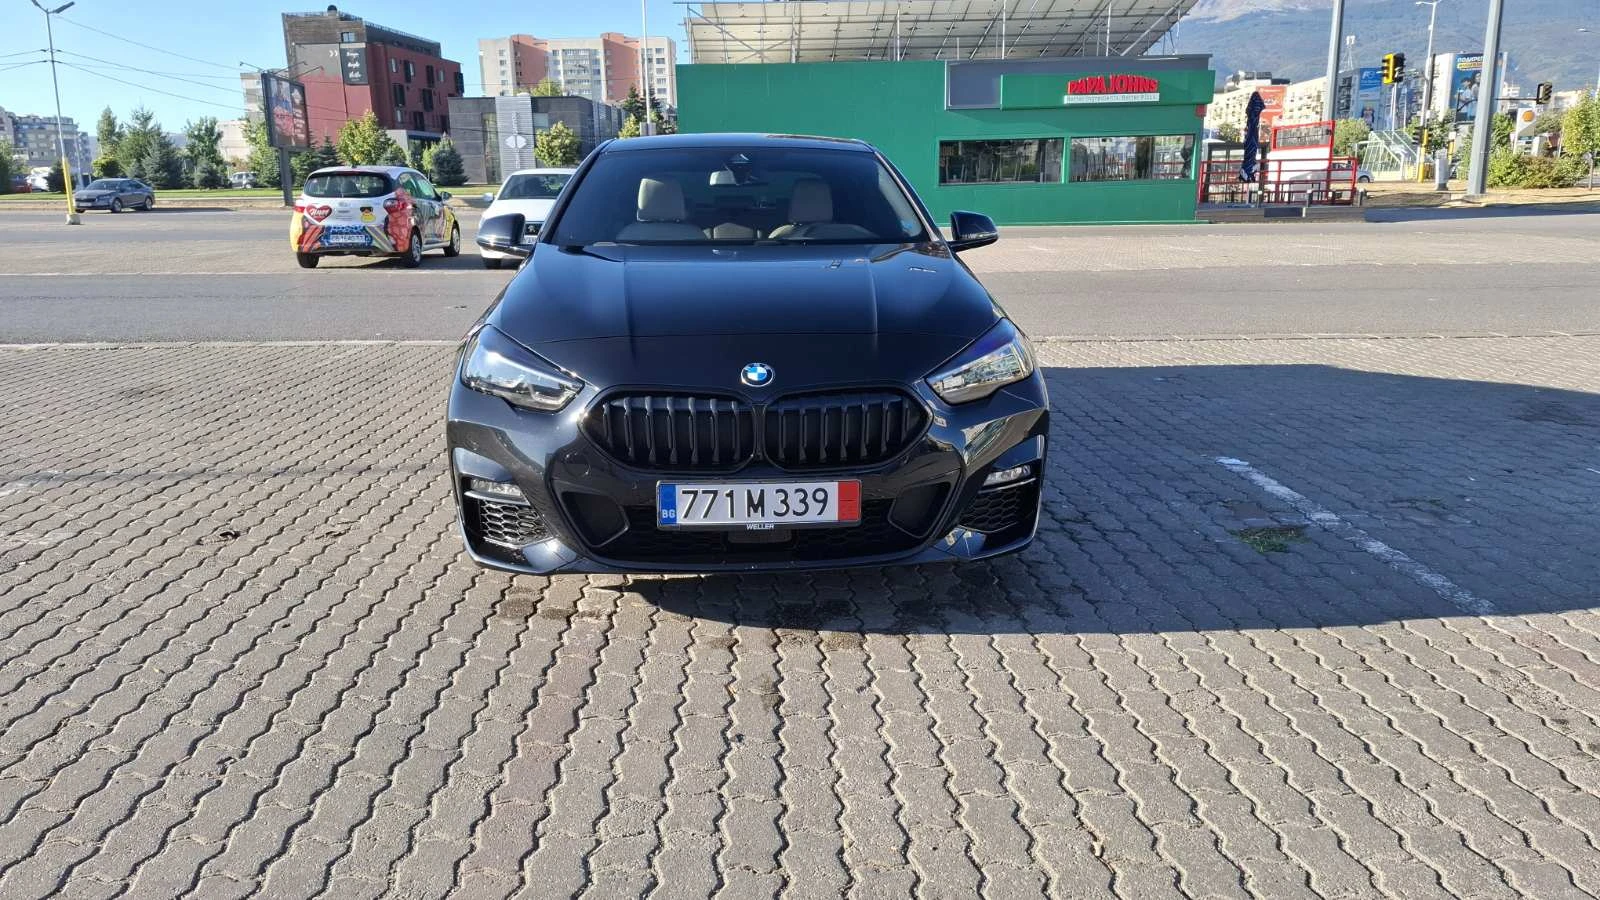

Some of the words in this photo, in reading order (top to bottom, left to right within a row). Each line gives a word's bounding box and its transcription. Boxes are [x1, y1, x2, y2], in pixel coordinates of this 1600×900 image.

[1068, 76, 1106, 94] PAPA
[661, 509, 676, 518] BG
[746, 523, 775, 531] WELLER
